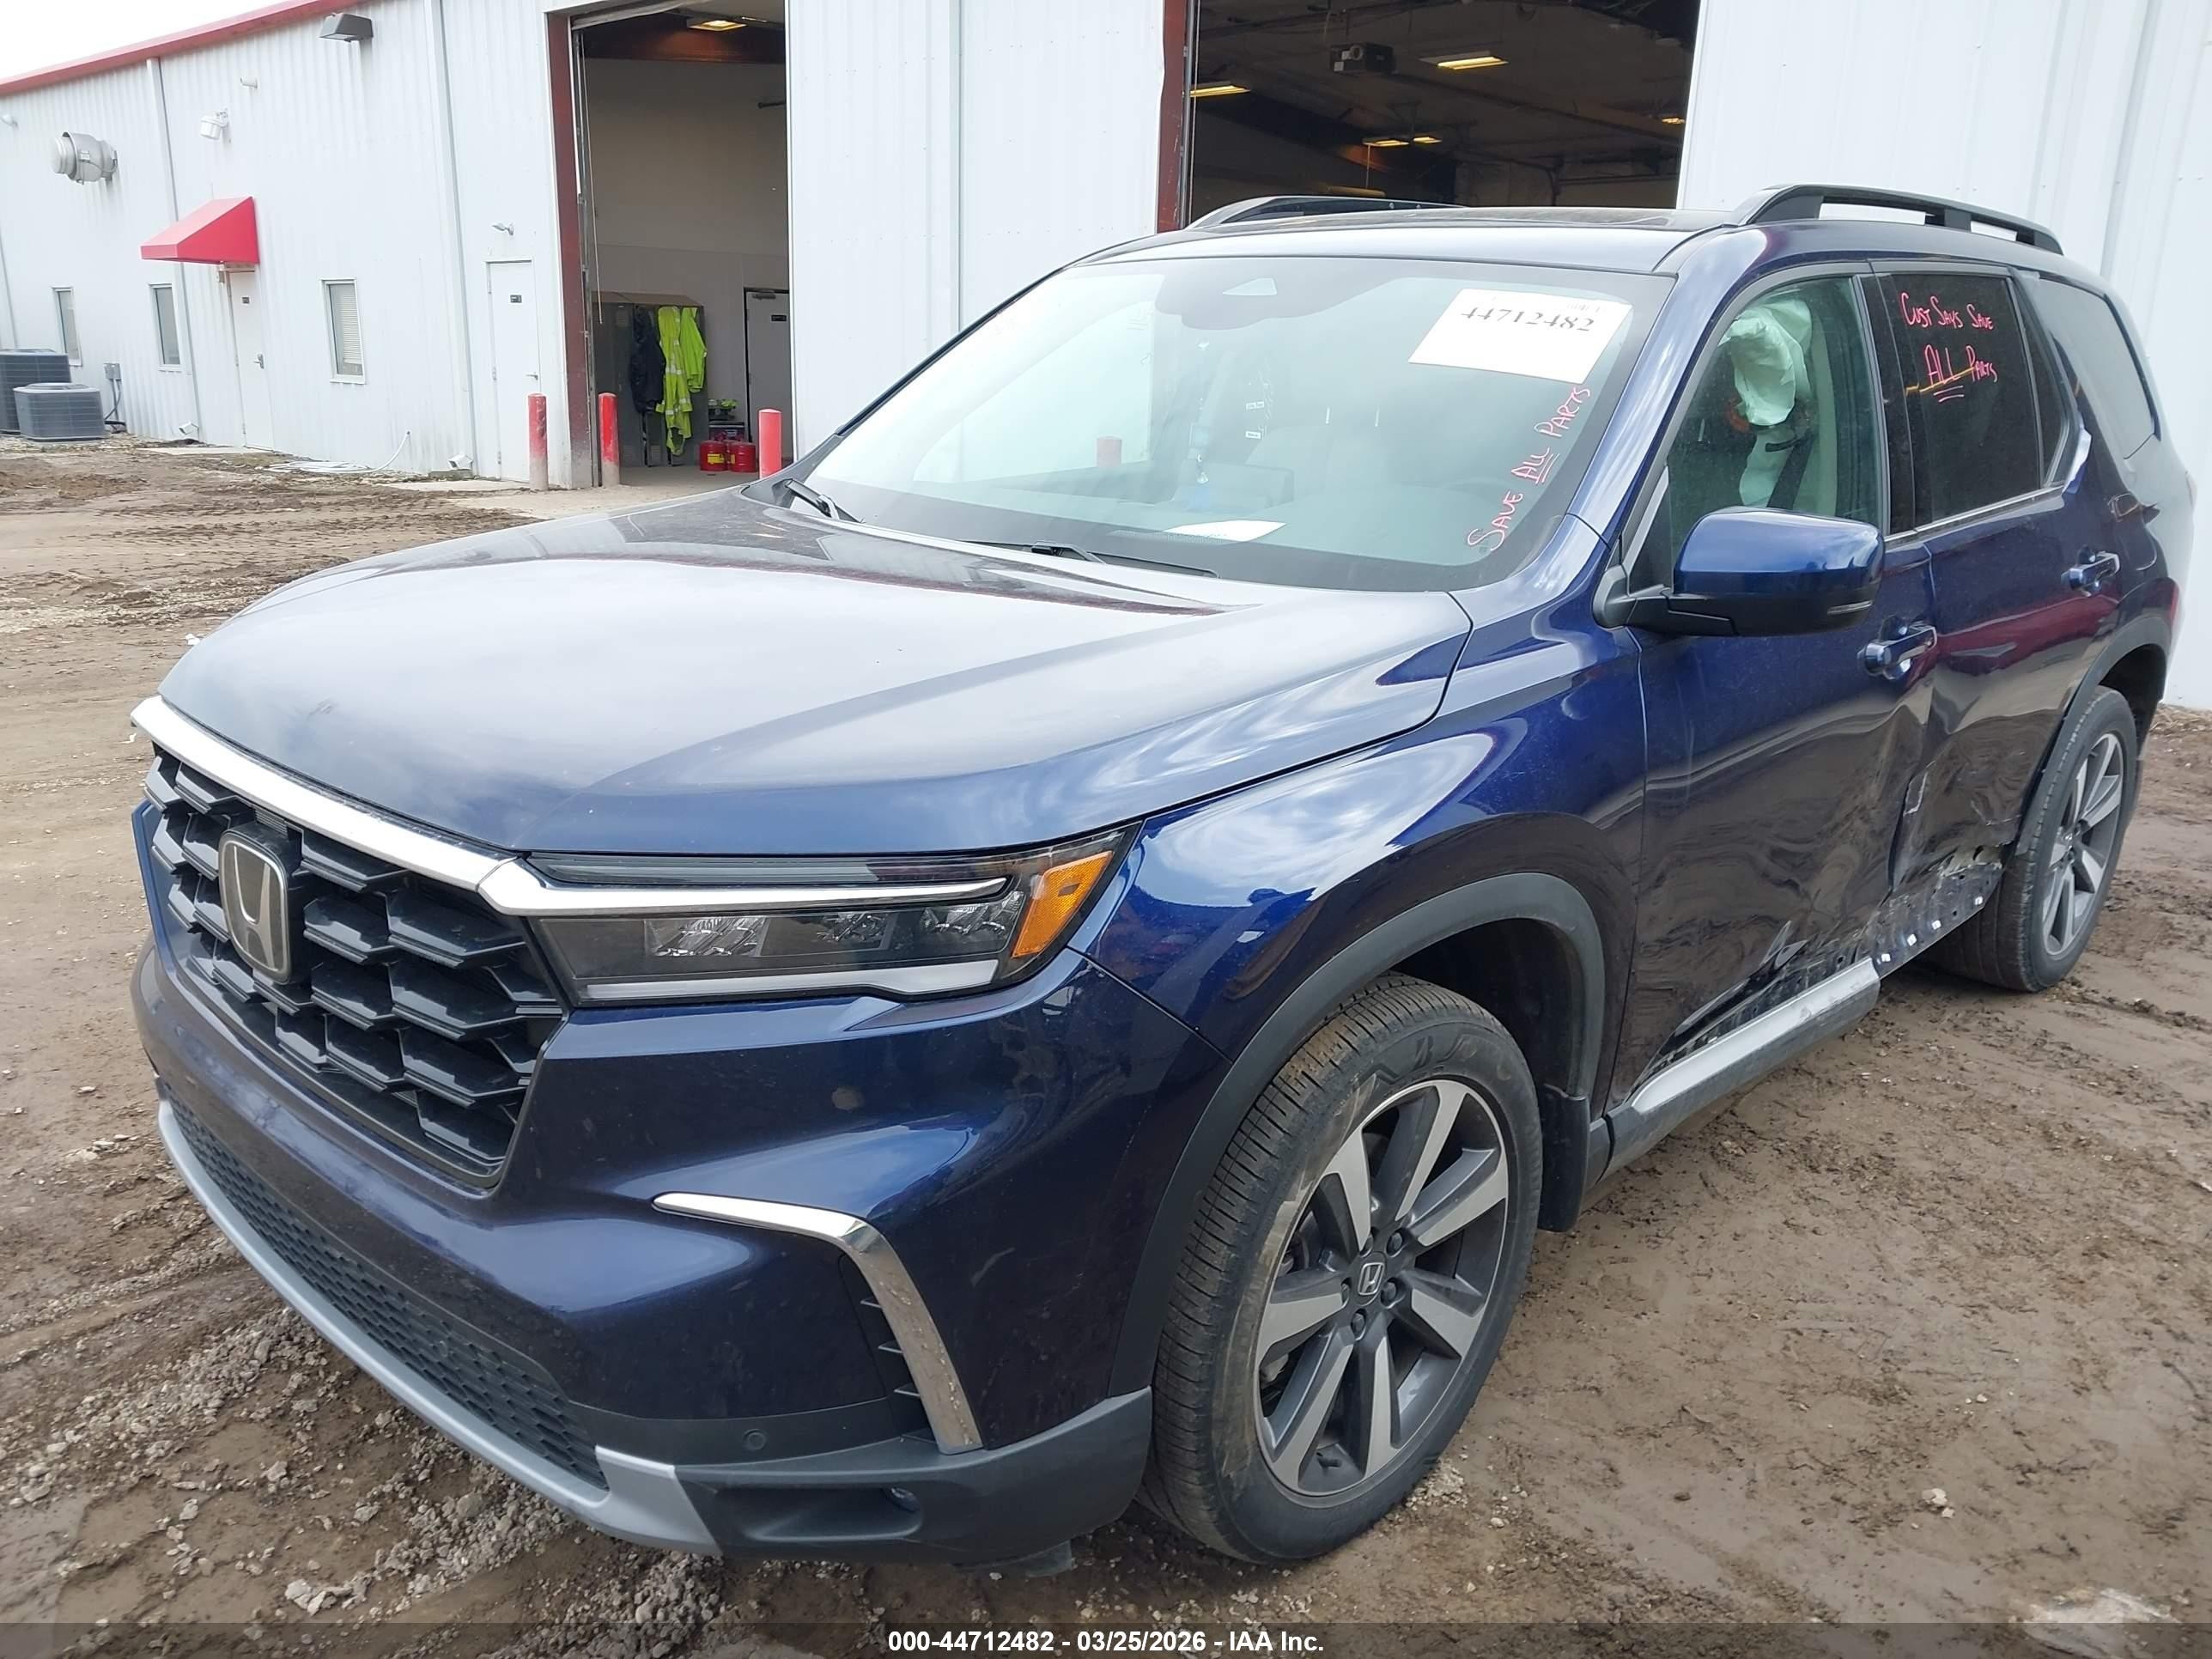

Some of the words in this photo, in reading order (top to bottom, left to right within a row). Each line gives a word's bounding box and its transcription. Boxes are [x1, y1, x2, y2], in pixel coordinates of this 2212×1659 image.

[1462, 307, 1595, 331] 44712482
[1924, 344, 1961, 386] ALL
[1467, 490, 1523, 551] SAVE
[1511, 447, 1551, 485] ALL
[1534, 386, 1590, 438] PARTS
